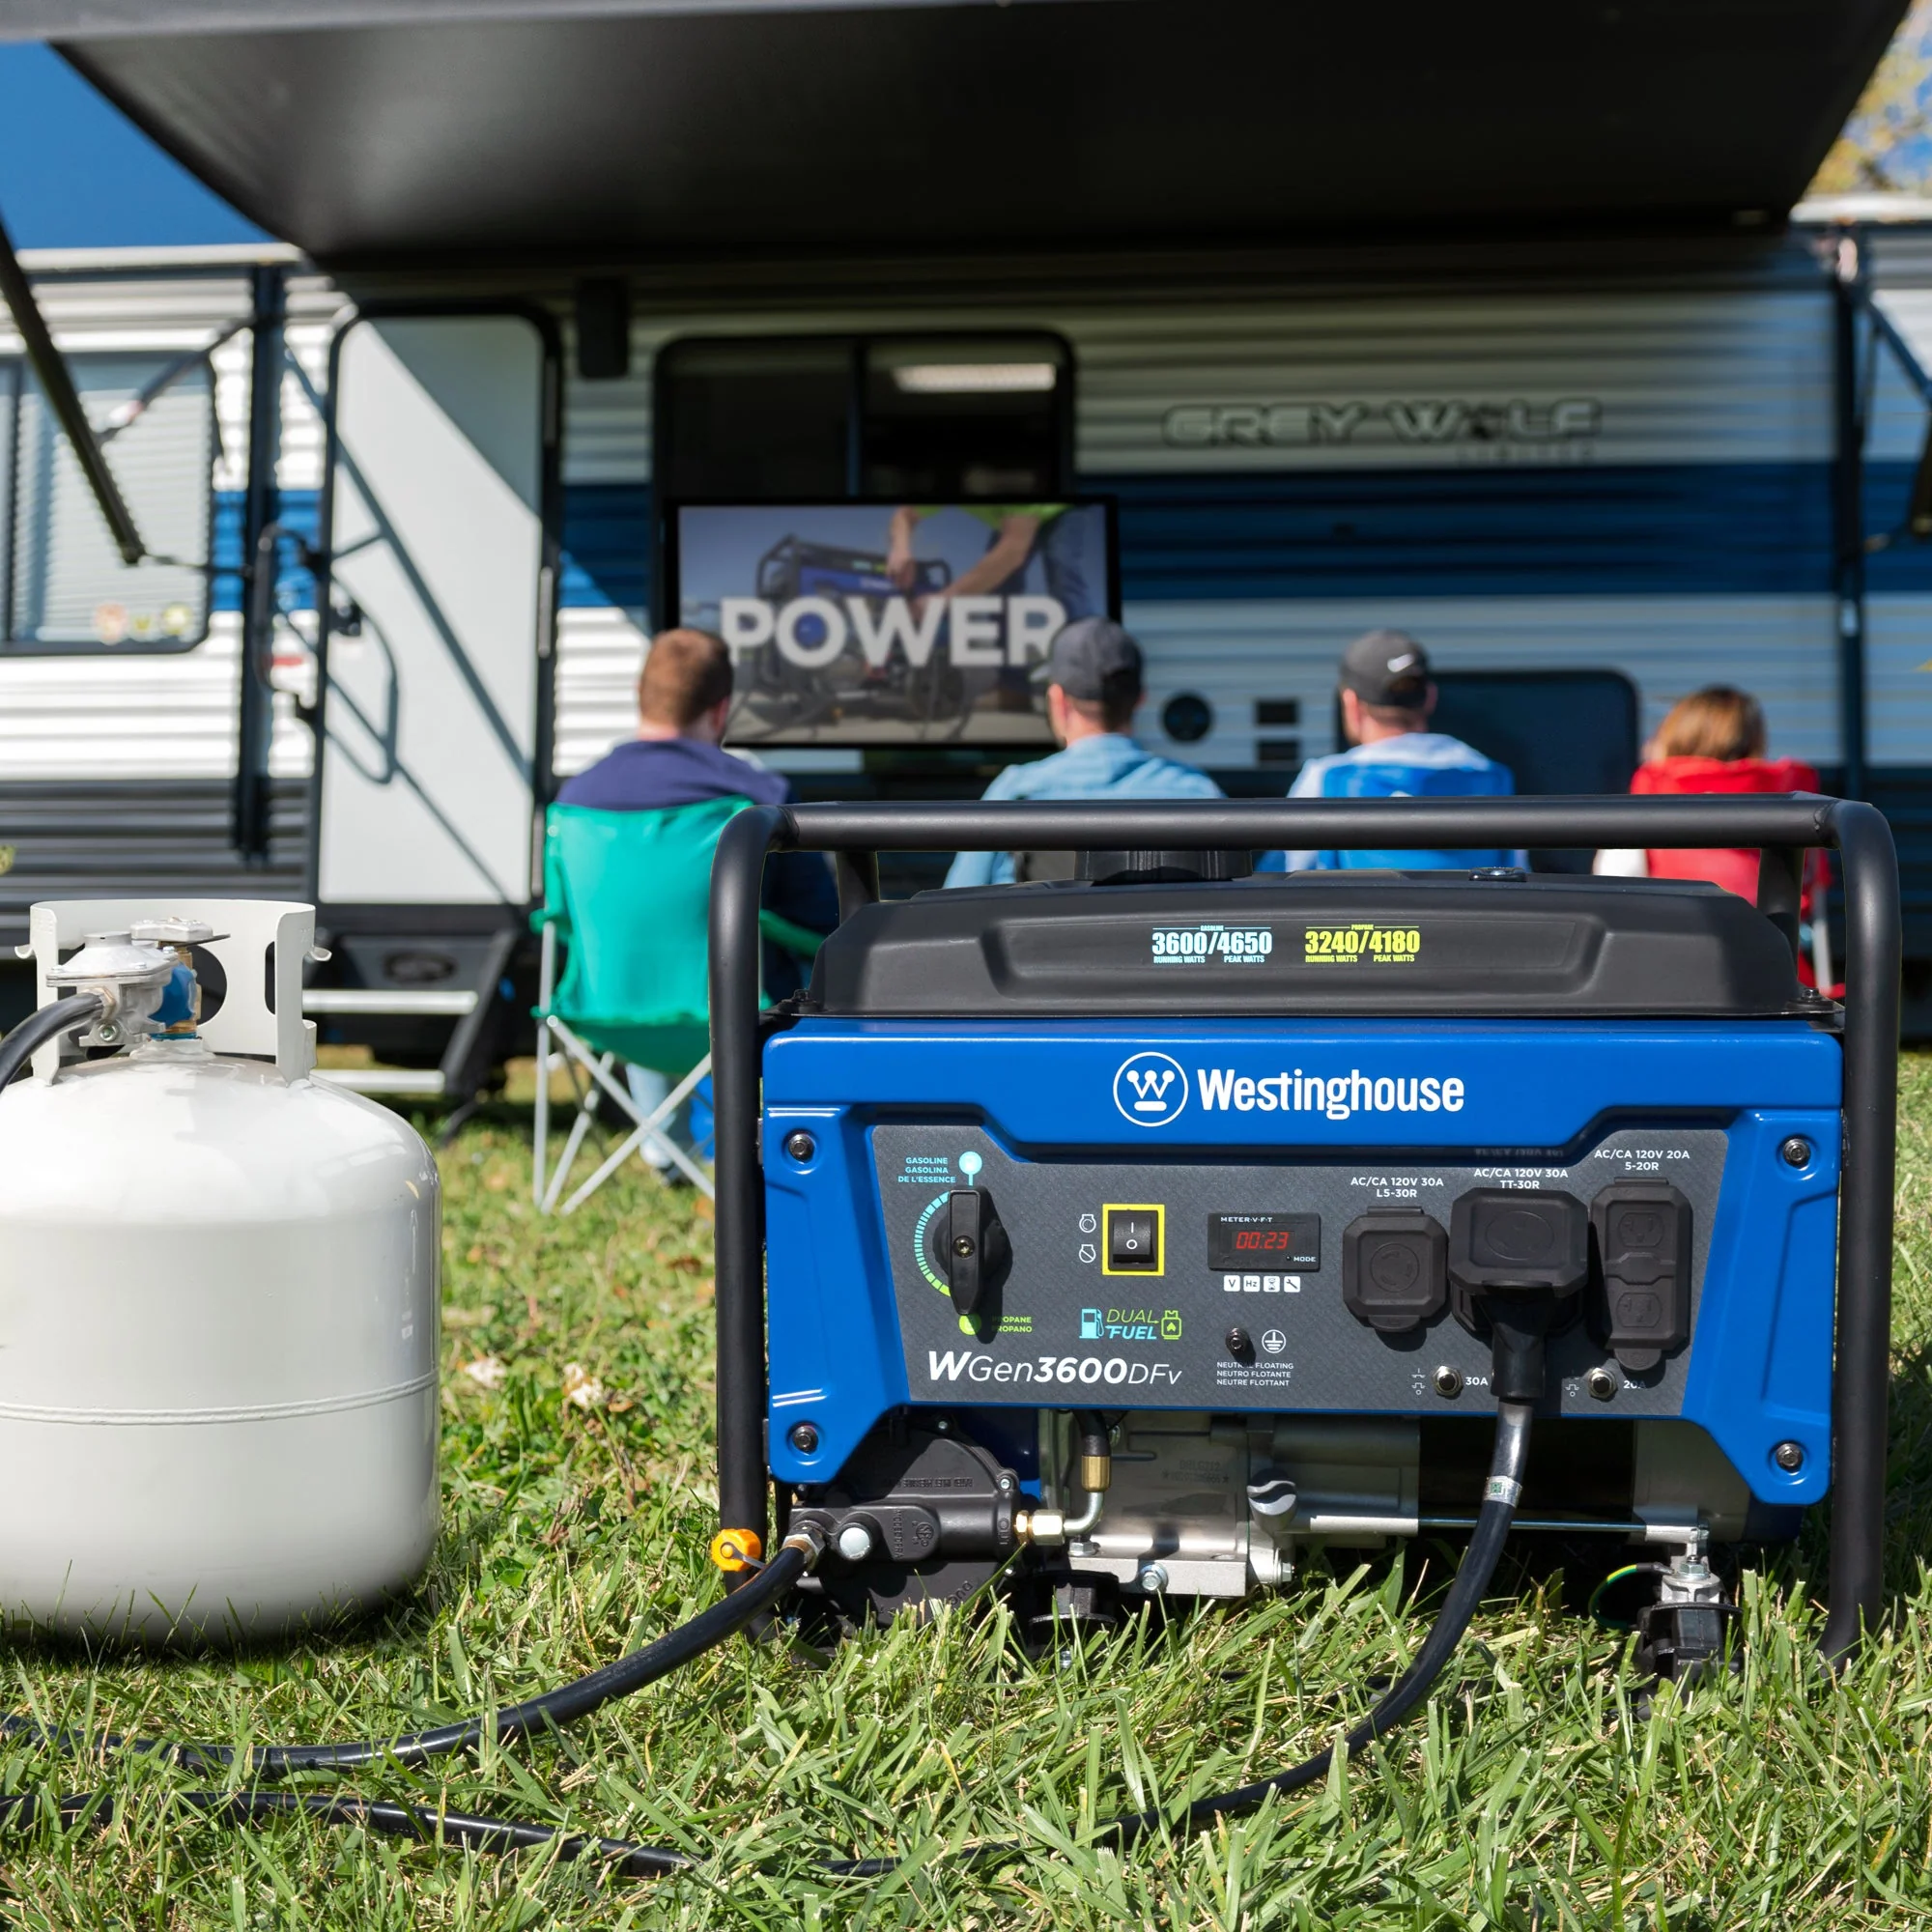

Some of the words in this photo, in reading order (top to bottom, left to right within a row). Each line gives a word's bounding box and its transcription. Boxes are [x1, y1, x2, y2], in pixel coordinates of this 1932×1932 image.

[1162, 404, 1369, 448] GREY
[721, 595, 1066, 668] POWER
[1151, 931, 1272, 955] 3600/4650
[1305, 930, 1420, 953] 3240/4180
[1197, 1068, 1464, 1120] Westinghouse
[1594, 1149, 1633, 1159] AC/CA
[1635, 1150, 1663, 1159] 120V
[1666, 1150, 1690, 1159] 20A
[1473, 1167, 1512, 1179] AC/CA
[1515, 1169, 1543, 1178] 120V
[1546, 1169, 1569, 1178] 30A
[1625, 1161, 1660, 1171] 5-20R
[1350, 1177, 1388, 1187] AC/CA
[1390, 1178, 1418, 1186] 120V
[1421, 1178, 1444, 1187] 30A
[1499, 1179, 1540, 1189] TT-30R
[1376, 1188, 1418, 1198] L5-30R
[1236, 1231, 1290, 1250] 00:23
[1228, 1278, 1236, 1289] V
[1106, 1308, 1159, 1324] DUAL
[1104, 1324, 1157, 1341] FUEL
[928, 1350, 1182, 1385] WGen3600DFv
[1464, 1377, 1489, 1386] 30A
